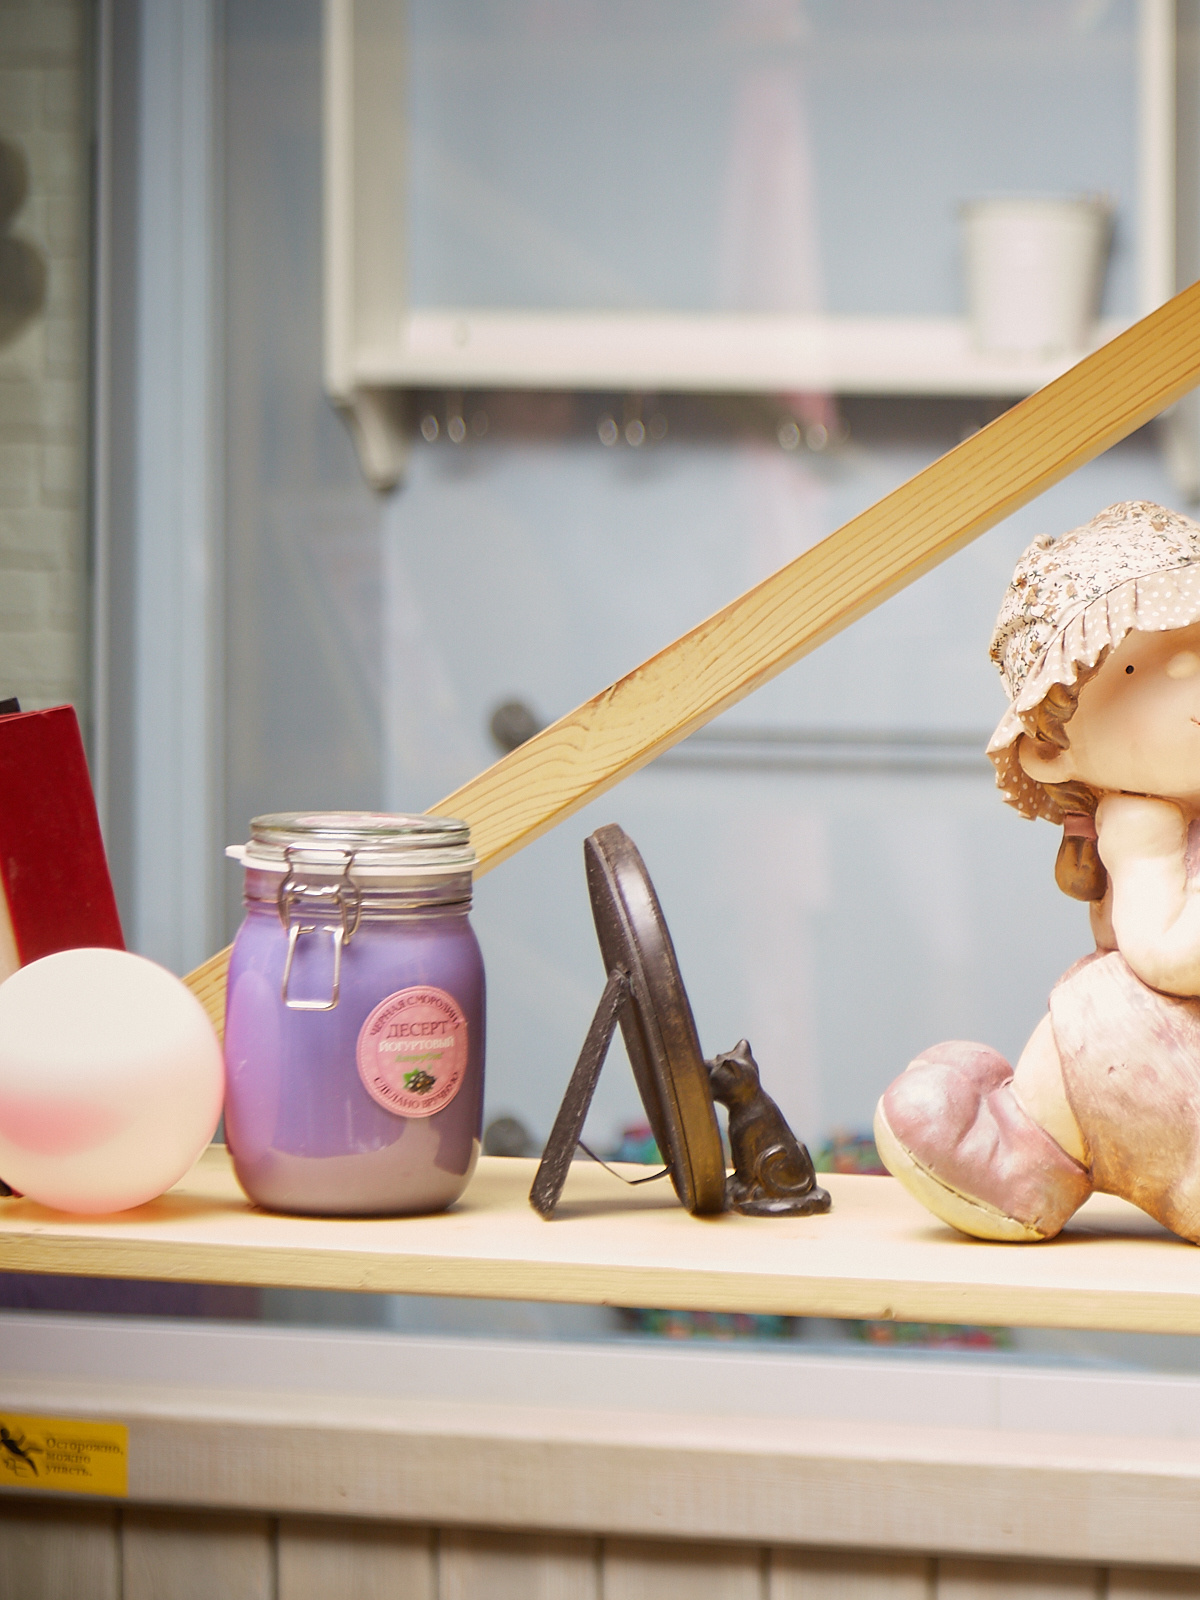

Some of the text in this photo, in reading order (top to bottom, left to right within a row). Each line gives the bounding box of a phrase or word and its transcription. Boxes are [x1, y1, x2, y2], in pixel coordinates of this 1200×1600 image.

[370, 999, 405, 1036] ЧЕРНАЯ
[386, 1020, 449, 1038] ДЕСЕРТ
[379, 1037, 454, 1052] ЙОГУРТОВЫЙ
[373, 1076, 421, 1109] СДЕЛАНО
[46, 1438, 124, 1457] Осторожно,
